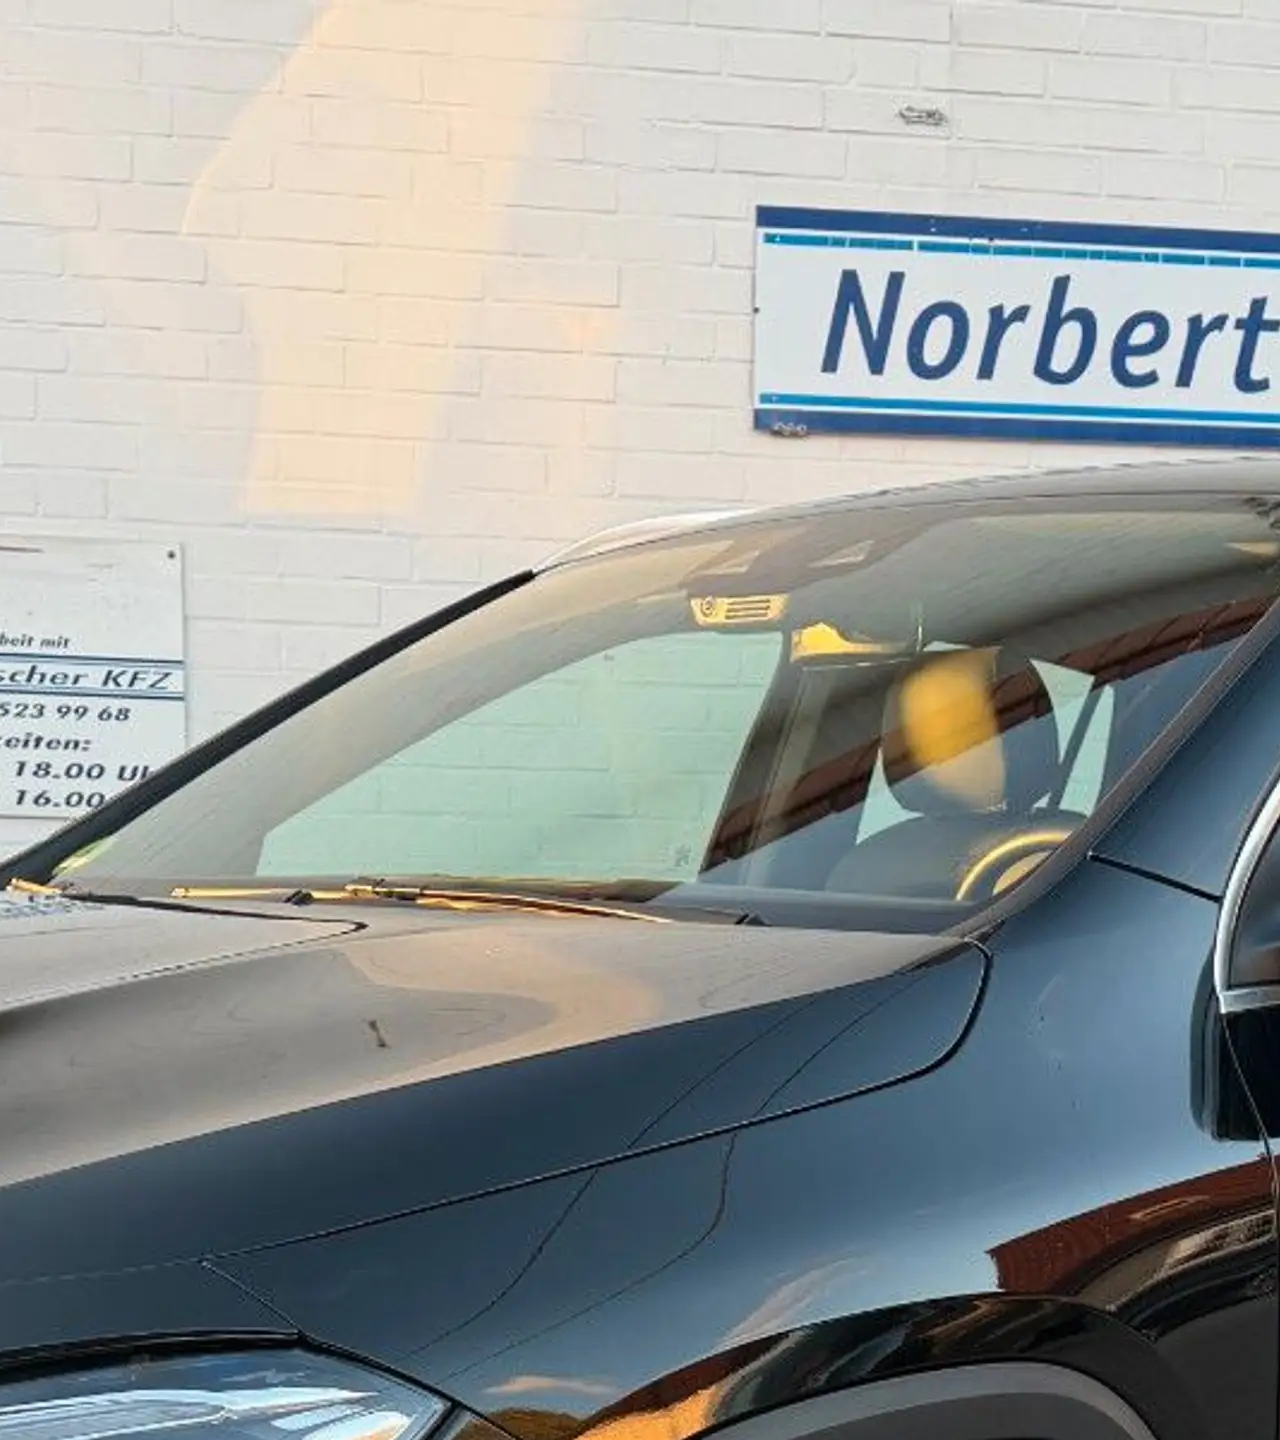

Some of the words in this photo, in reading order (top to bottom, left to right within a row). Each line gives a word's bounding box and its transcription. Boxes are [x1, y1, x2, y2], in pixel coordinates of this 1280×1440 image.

[39, 634, 71, 649] mit
[100, 668, 174, 690] KFZ
[55, 704, 89, 721] 99
[96, 706, 131, 722] 68
[14, 760, 106, 780] 18.00
[14, 789, 106, 809] 16.00
